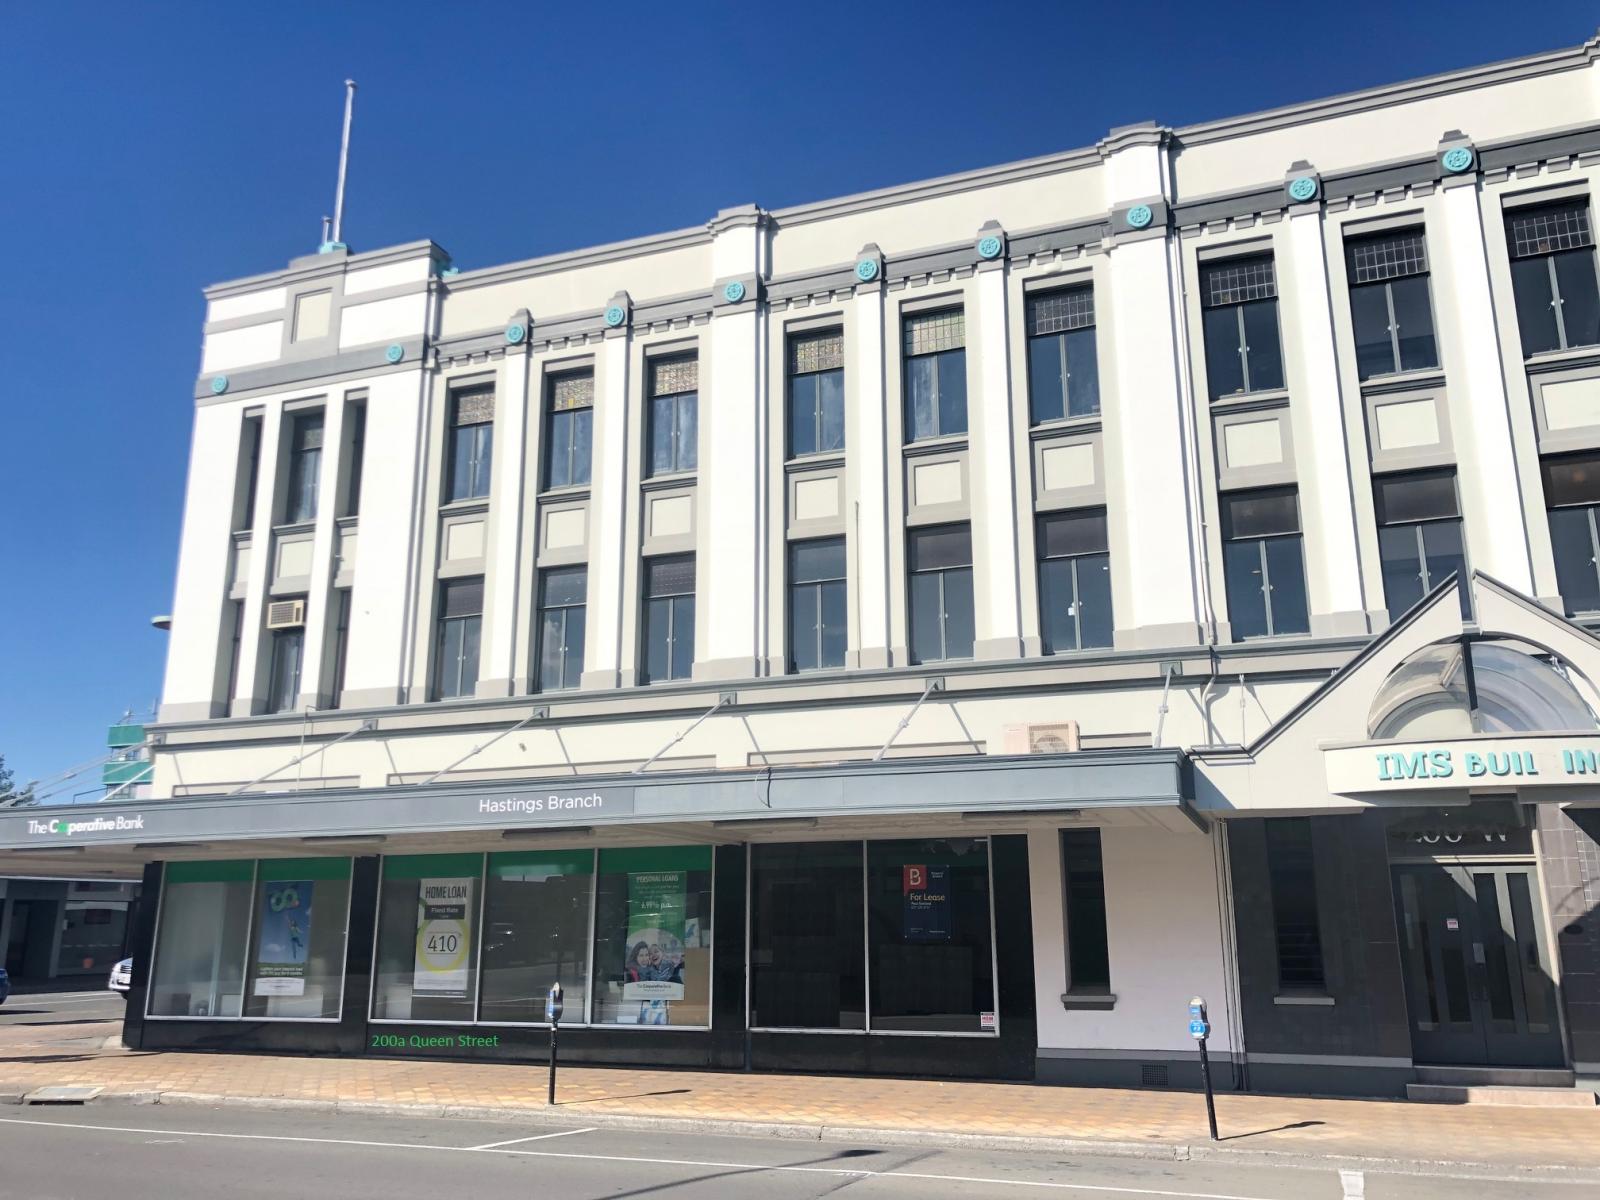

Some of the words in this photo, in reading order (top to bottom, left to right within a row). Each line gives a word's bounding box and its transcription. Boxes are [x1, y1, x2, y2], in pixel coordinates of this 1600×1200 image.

[1376, 750, 1453, 780] IMS
[1561, 749, 1600, 774] IN
[479, 798, 543, 813] Hastings
[548, 793, 603, 810] Branch
[27, 820, 48, 834] The
[116, 815, 144, 830] Bank
[909, 868, 921, 885] B
[425, 886, 447, 899] HOME
[448, 886, 467, 898] LOAN
[910, 893, 922, 901] For
[923, 893, 946, 901] Lease
[371, 1034, 406, 1047] 200a
[409, 1034, 454, 1048] Queen
[457, 1034, 499, 1047] Street
